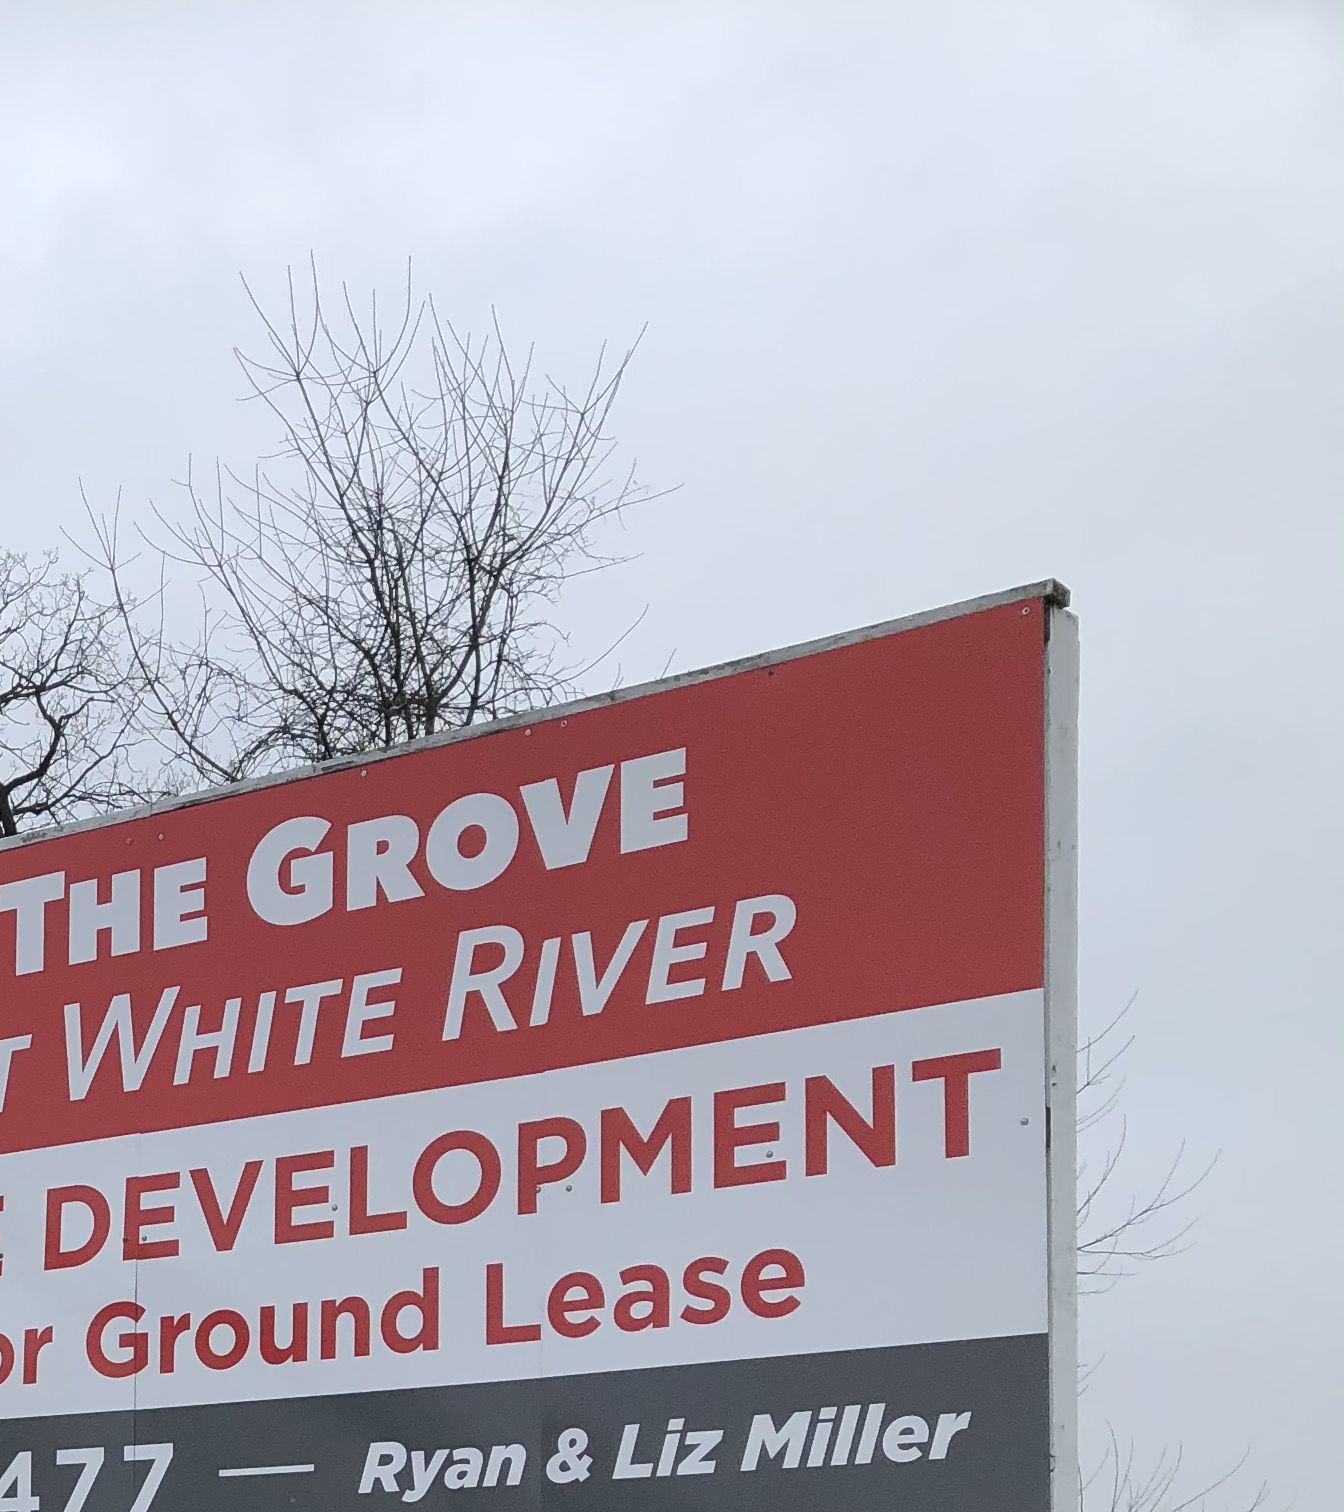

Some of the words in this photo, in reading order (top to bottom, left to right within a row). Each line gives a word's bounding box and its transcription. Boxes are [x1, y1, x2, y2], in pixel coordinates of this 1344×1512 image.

[246, 747, 690, 927] GROVE
[64, 968, 403, 1101] WHITE
[441, 894, 798, 1042] RIVER
[44, 1048, 1002, 1271] DEVELOPMENT
[86, 1267, 440, 1379] Ground
[485, 1248, 807, 1346] Lease
[357, 1440, 527, 1502] Ryan
[546, 1427, 594, 1484] &
[612, 1418, 725, 1480] Liz
[741, 1402, 972, 1473] Miller
